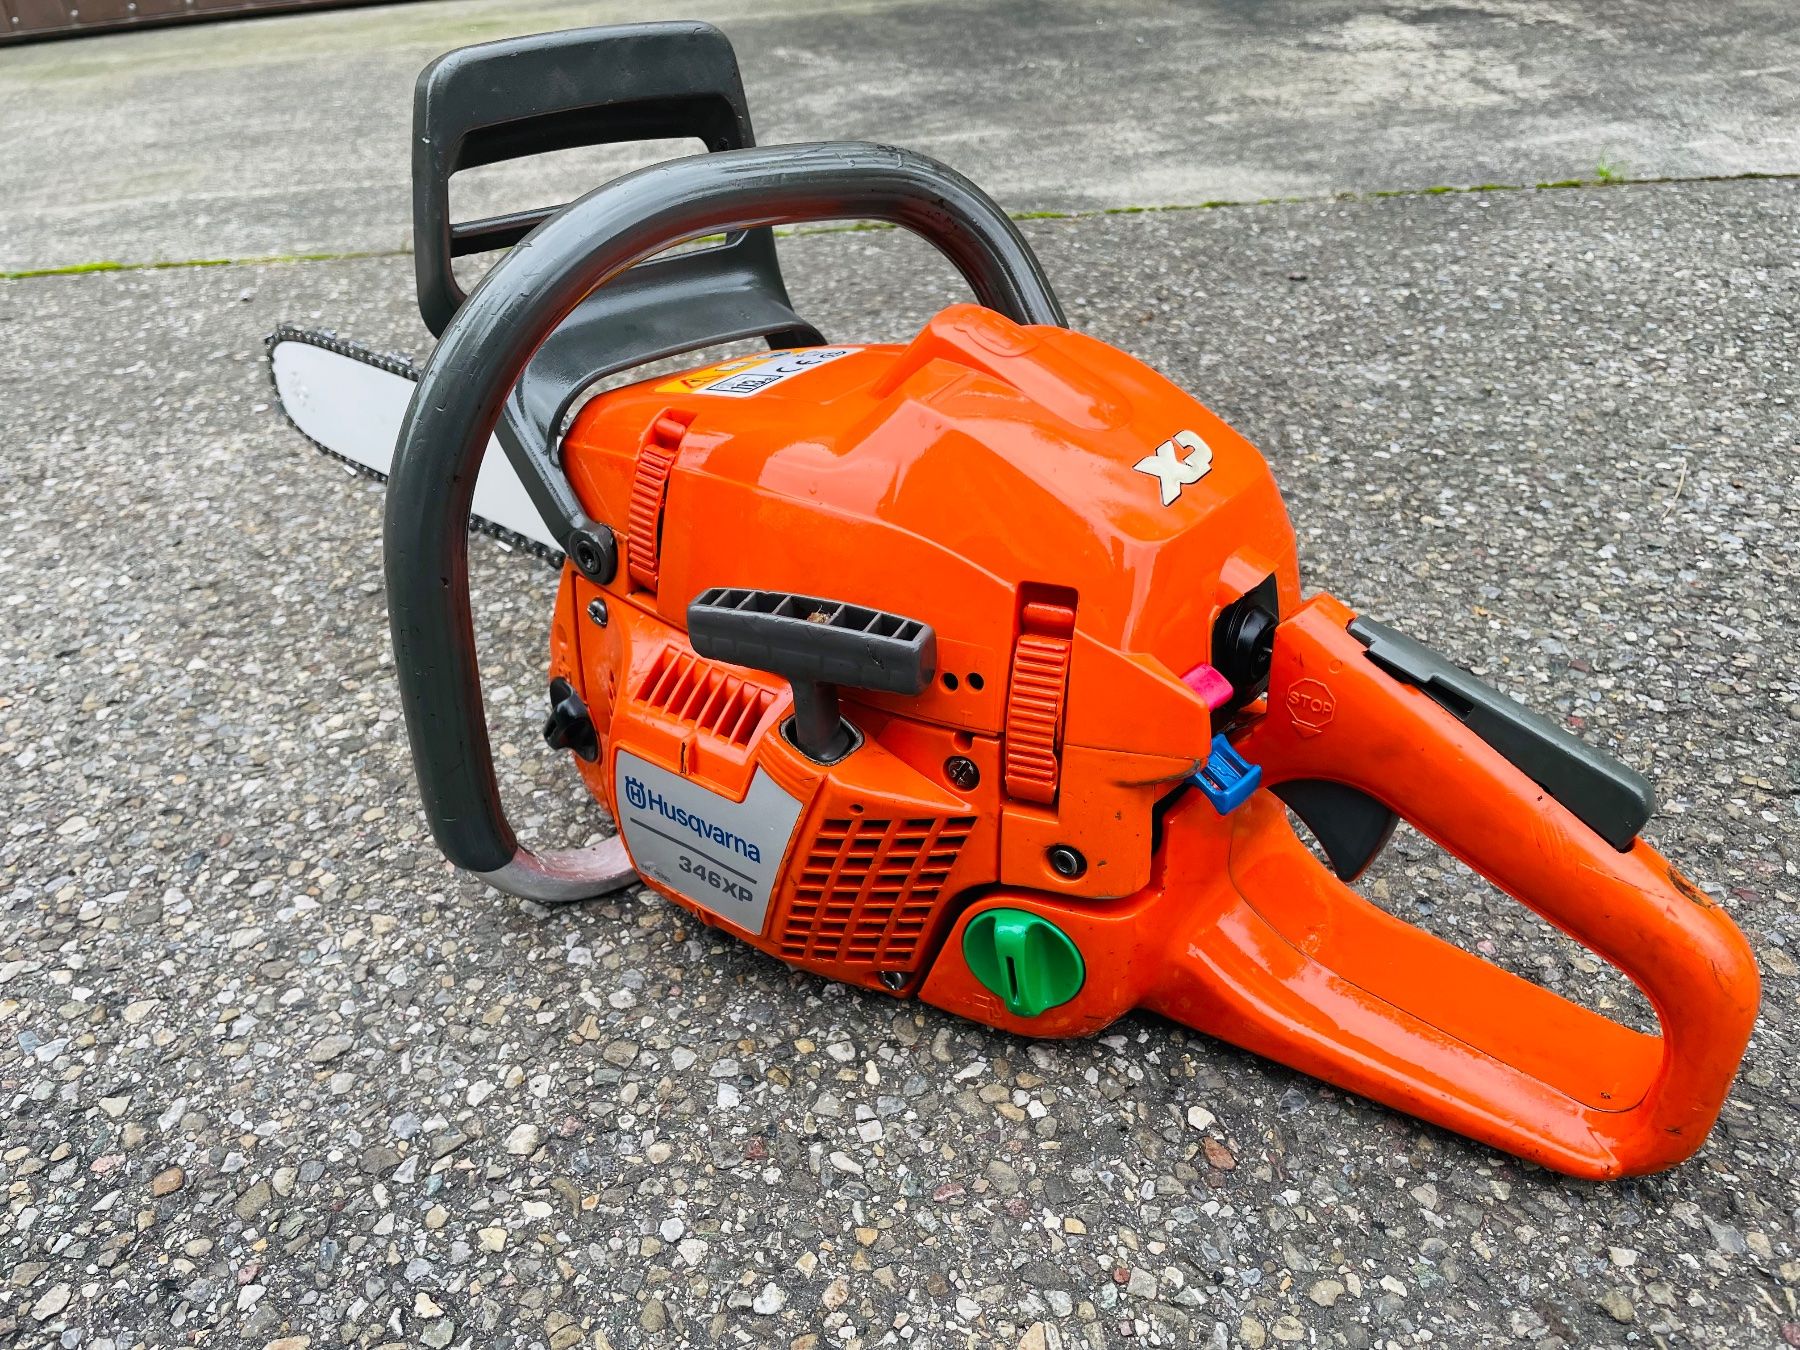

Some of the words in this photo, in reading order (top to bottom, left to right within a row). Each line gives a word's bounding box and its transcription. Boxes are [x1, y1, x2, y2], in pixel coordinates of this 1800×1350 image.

[1132, 429, 1213, 508] XP
[1288, 690, 1333, 715] STOP
[648, 788, 761, 864] Husqvarna
[679, 855, 754, 903] 346XP
